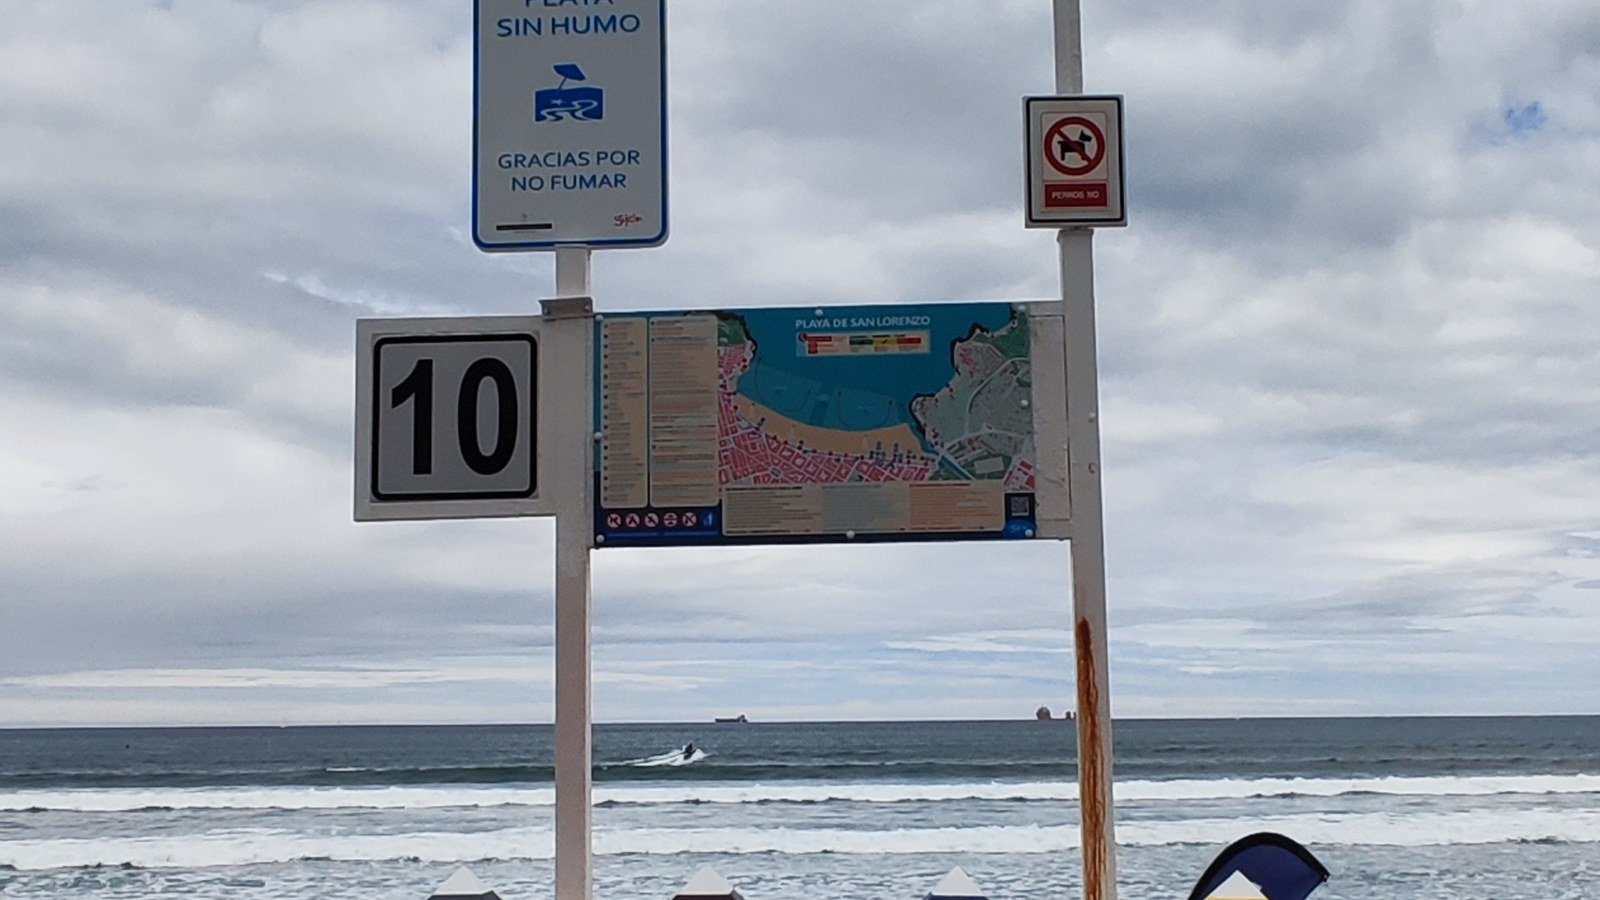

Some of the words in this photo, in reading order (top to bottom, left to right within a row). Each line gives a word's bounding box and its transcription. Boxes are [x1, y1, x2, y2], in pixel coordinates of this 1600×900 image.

[497, 17, 542, 37] SIN
[551, 14, 641, 35] HUMO
[498, 151, 591, 169] GRACIAS
[596, 150, 641, 165] POR
[511, 176, 544, 191] NO
[551, 174, 627, 190] FUMAR
[1052, 190, 1084, 199] PERROS
[1087, 190, 1100, 198] NO
[795, 318, 831, 329] PLAYA
[833, 318, 848, 327] DE
[850, 317, 875, 327] SAN
[877, 315, 931, 327] LORENZO
[391, 357, 518, 476] 10
